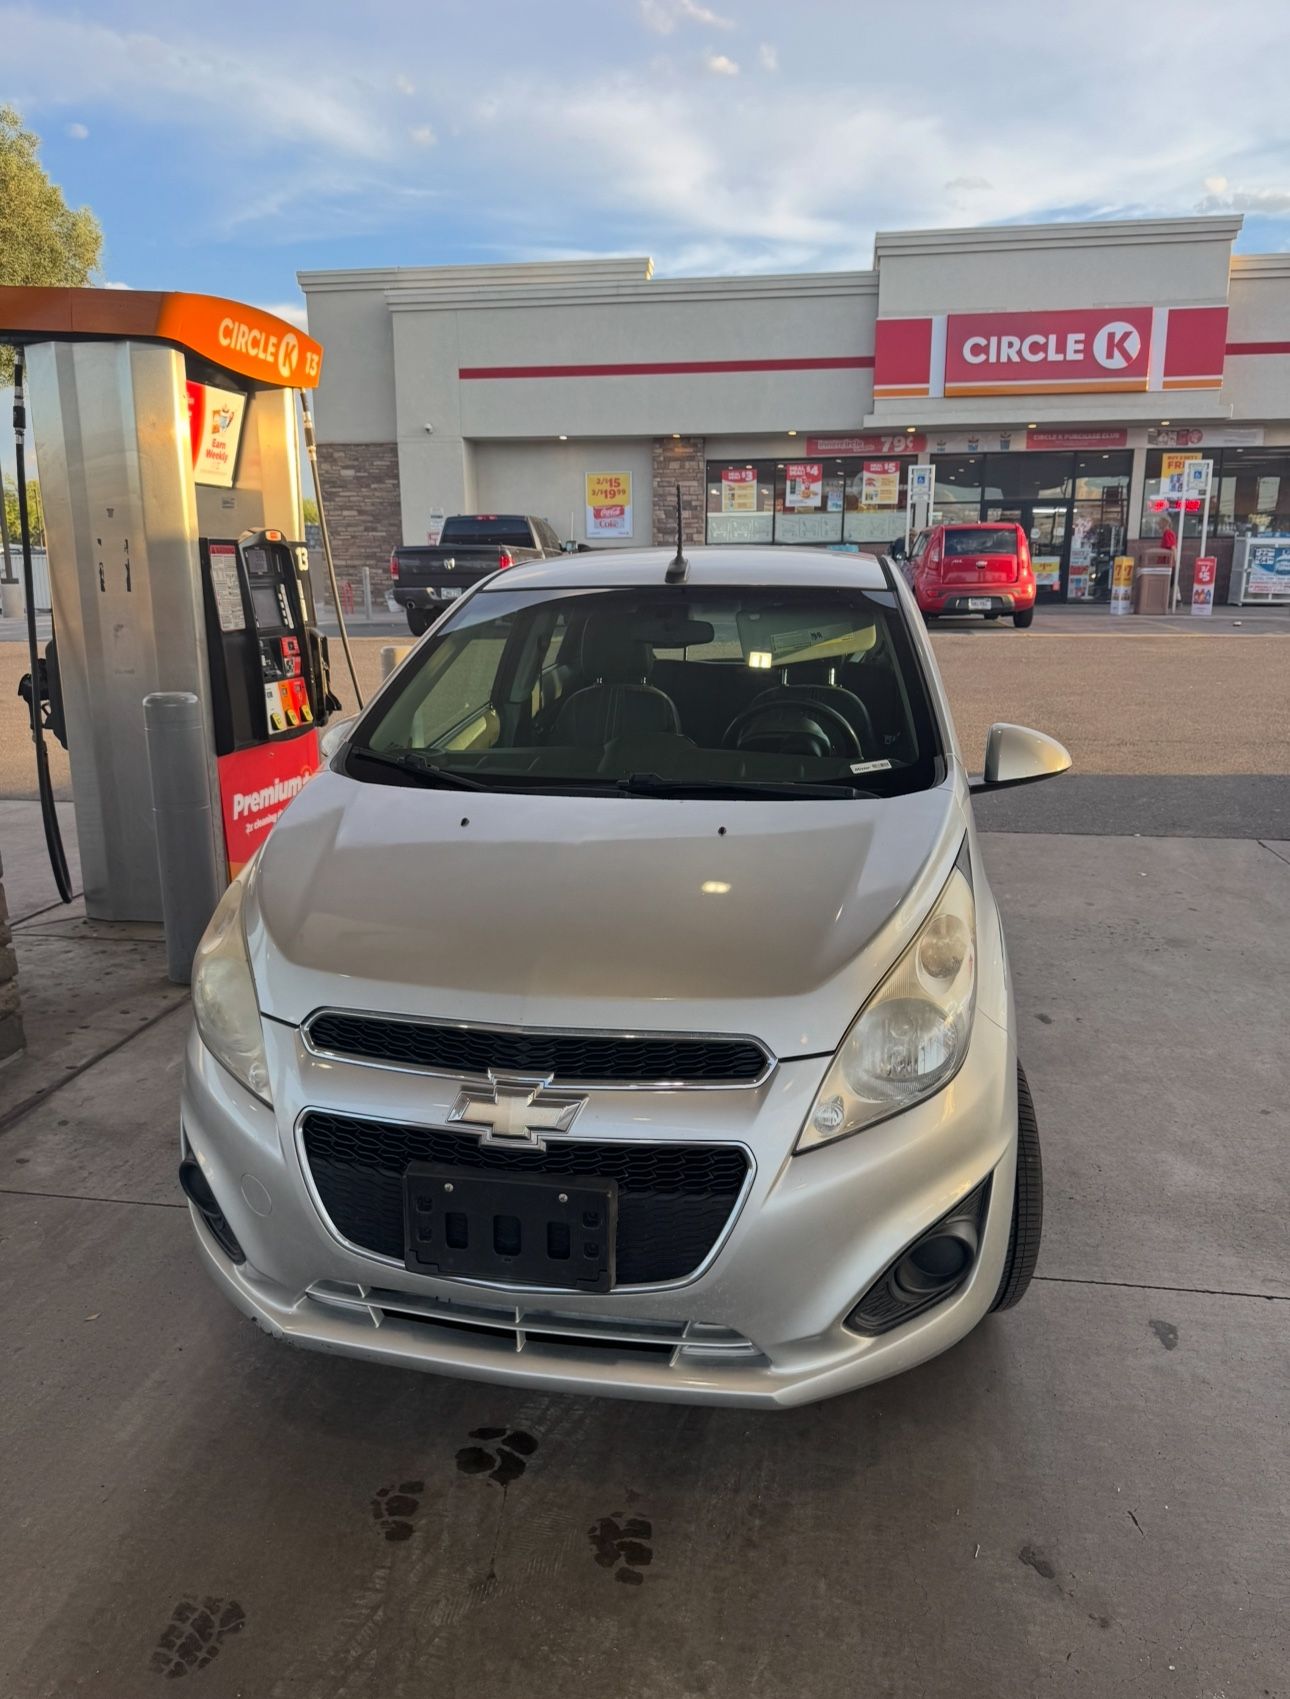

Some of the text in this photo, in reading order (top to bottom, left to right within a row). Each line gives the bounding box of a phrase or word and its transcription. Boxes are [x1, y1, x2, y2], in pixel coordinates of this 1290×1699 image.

[218, 317, 320, 378] CIRCLE K 13
[962, 326, 1139, 368] CIRCLE K
[211, 437, 227, 450] Earn
[880, 434, 915, 453] 79¢
[205, 448, 229, 465] Weekly
[884, 462, 896, 473] $5
[295, 546, 309, 572] 13
